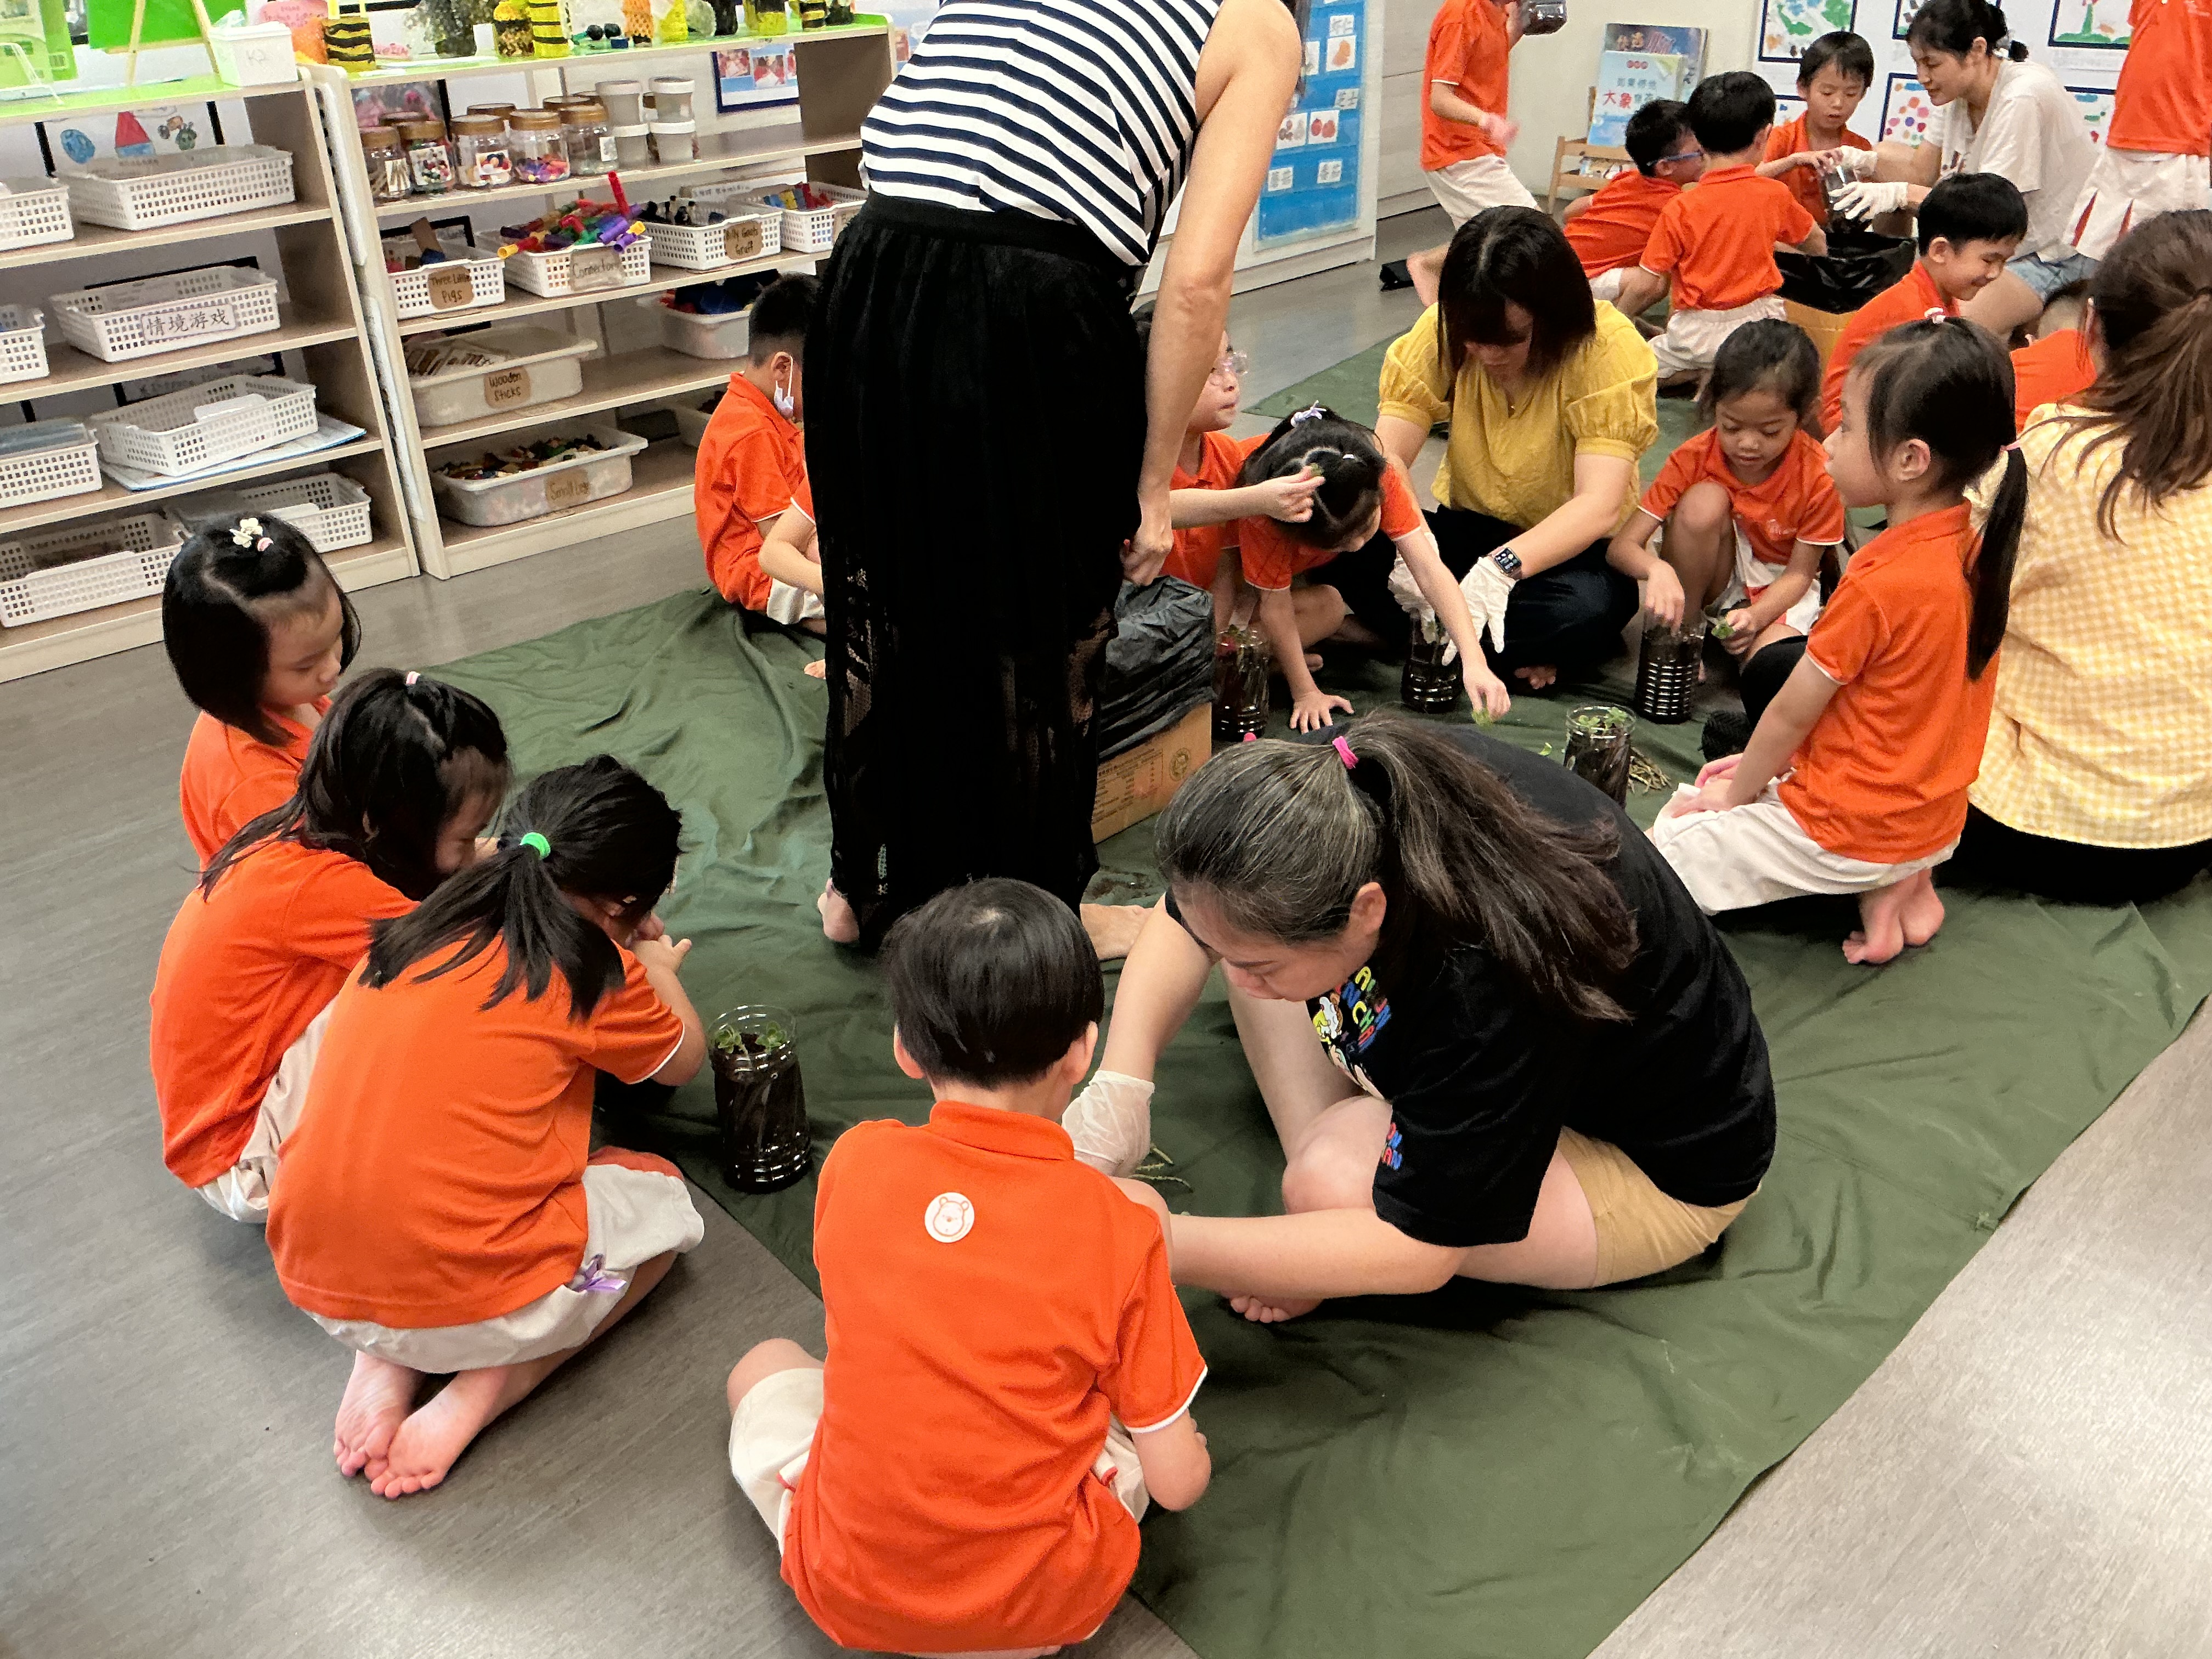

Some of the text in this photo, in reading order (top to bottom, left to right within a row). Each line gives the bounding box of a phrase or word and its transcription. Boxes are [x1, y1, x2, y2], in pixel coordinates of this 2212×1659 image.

[146, 308, 229, 336] 情境游戏
[488, 372, 522, 387] Wooden
